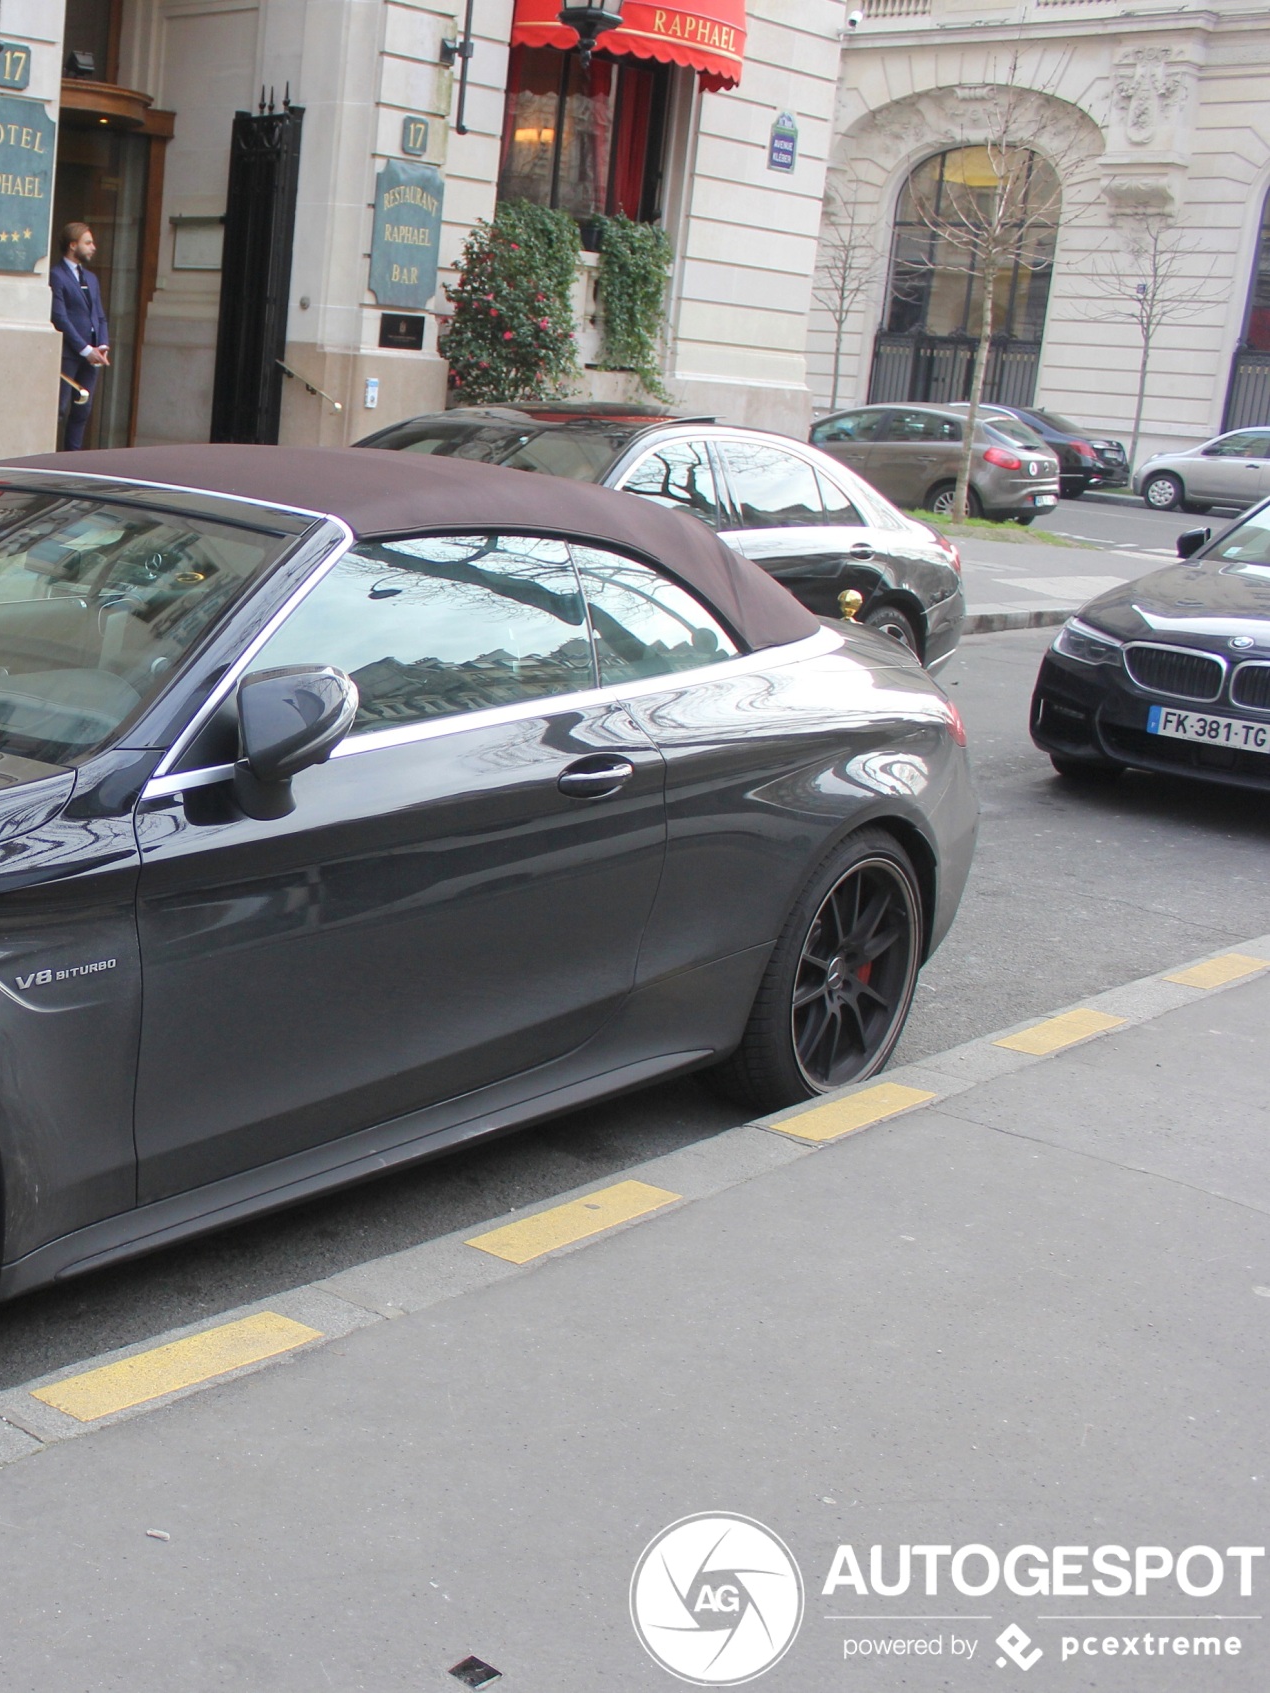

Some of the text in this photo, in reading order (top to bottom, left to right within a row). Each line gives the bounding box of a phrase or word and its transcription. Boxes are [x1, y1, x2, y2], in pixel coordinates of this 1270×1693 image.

[653, 9, 736, 52] RAPHAEL
[4, 50, 26, 81] 17
[408, 122, 425, 149] 17
[773, 139, 794, 151] AVENUE
[383, 185, 439, 217] RESTAURANT
[384, 223, 432, 246] RAPHAEL
[391, 264, 418, 284] BAR
[1163, 712, 1267, 747] FK-381-TG
[15, 958, 117, 990] V8 BITURBO
